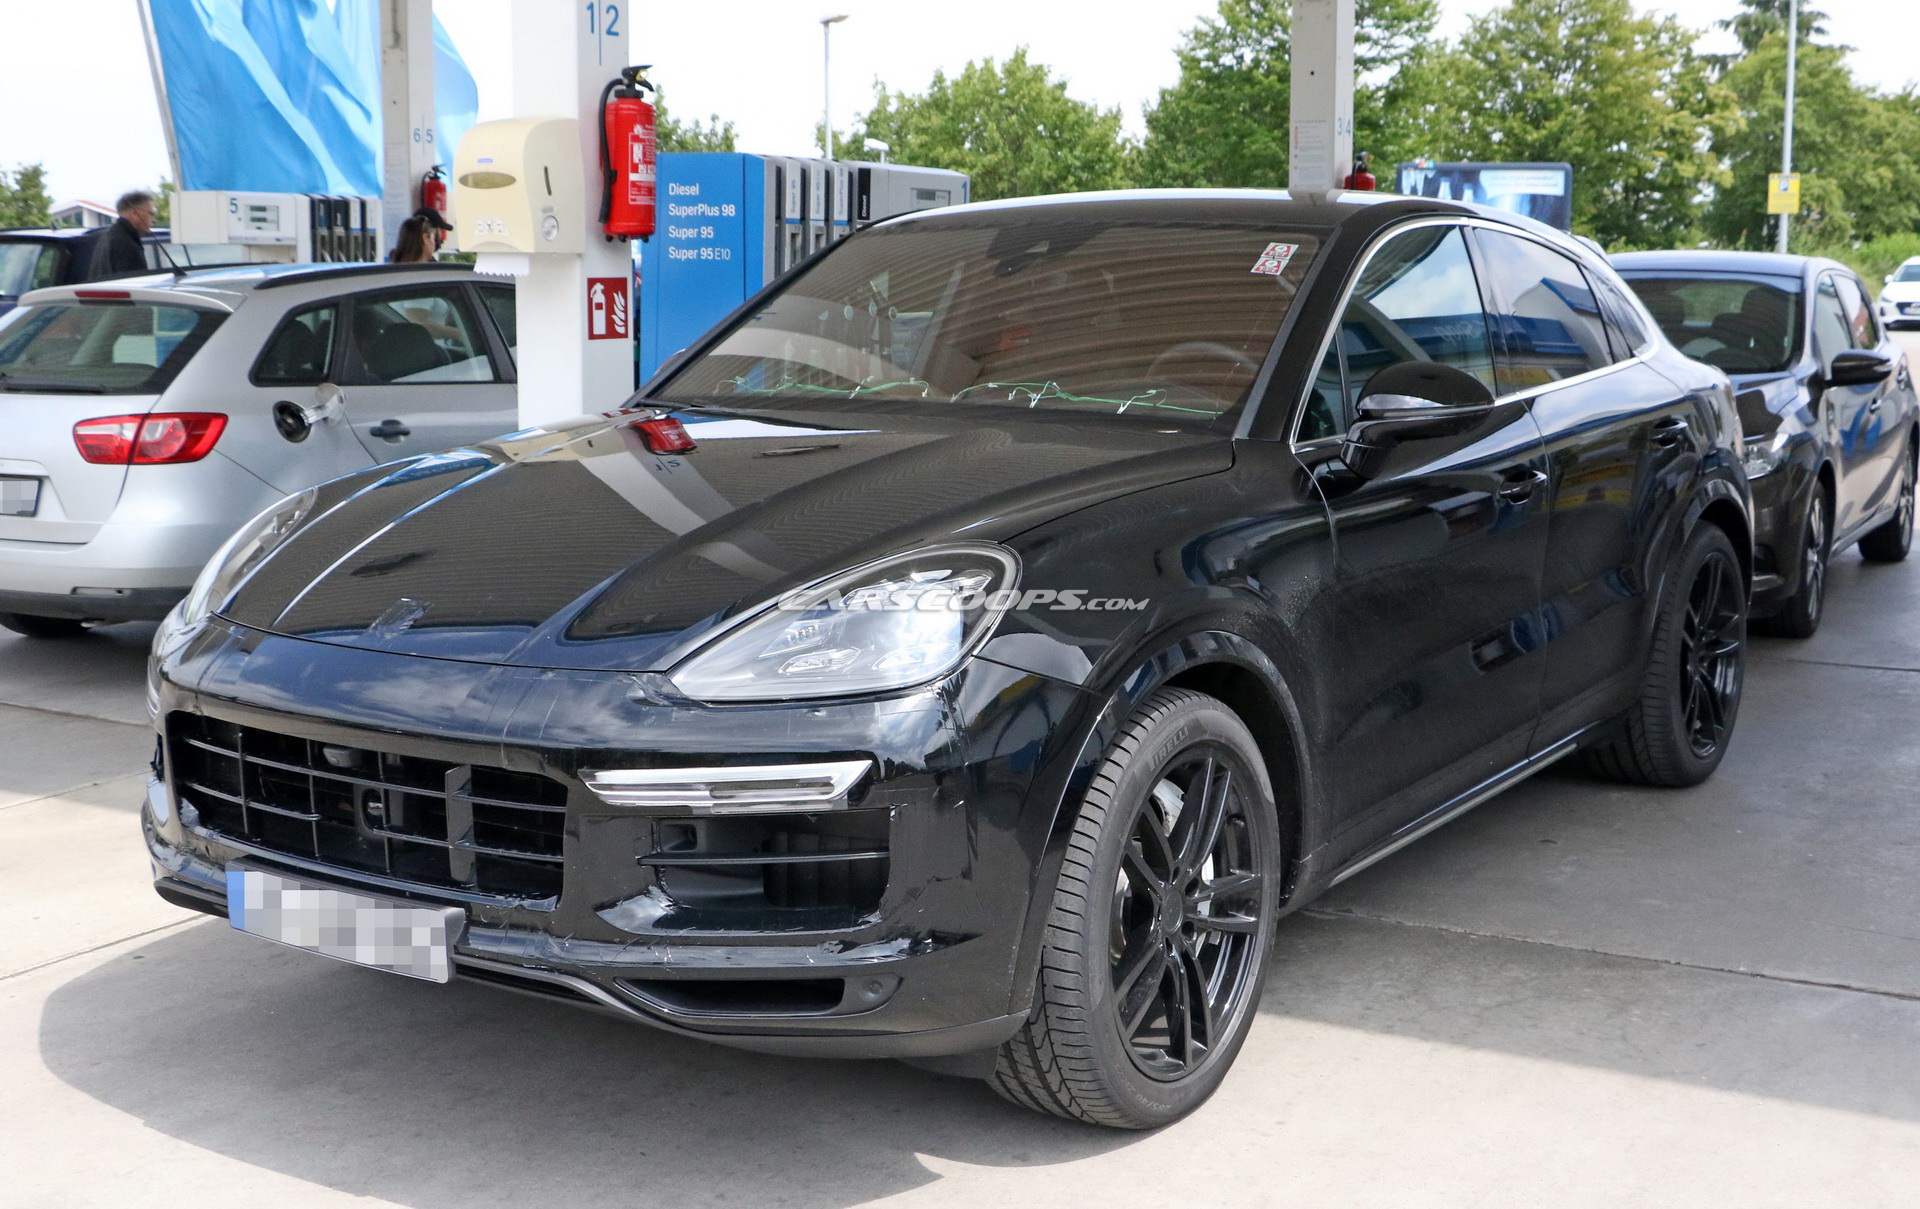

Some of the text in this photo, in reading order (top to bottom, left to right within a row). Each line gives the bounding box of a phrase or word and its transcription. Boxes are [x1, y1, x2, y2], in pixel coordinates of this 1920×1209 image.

[586, 2, 619, 36] 1 2
[1337, 117, 1351, 136] 3 4
[413, 127, 433, 143] 6 5
[668, 183, 699, 196] Diesel
[229, 198, 239, 214] 5
[668, 203, 736, 218] SuperPlus 98
[668, 225, 714, 240] Super 95
[668, 246, 731, 261] Super 95 E10
